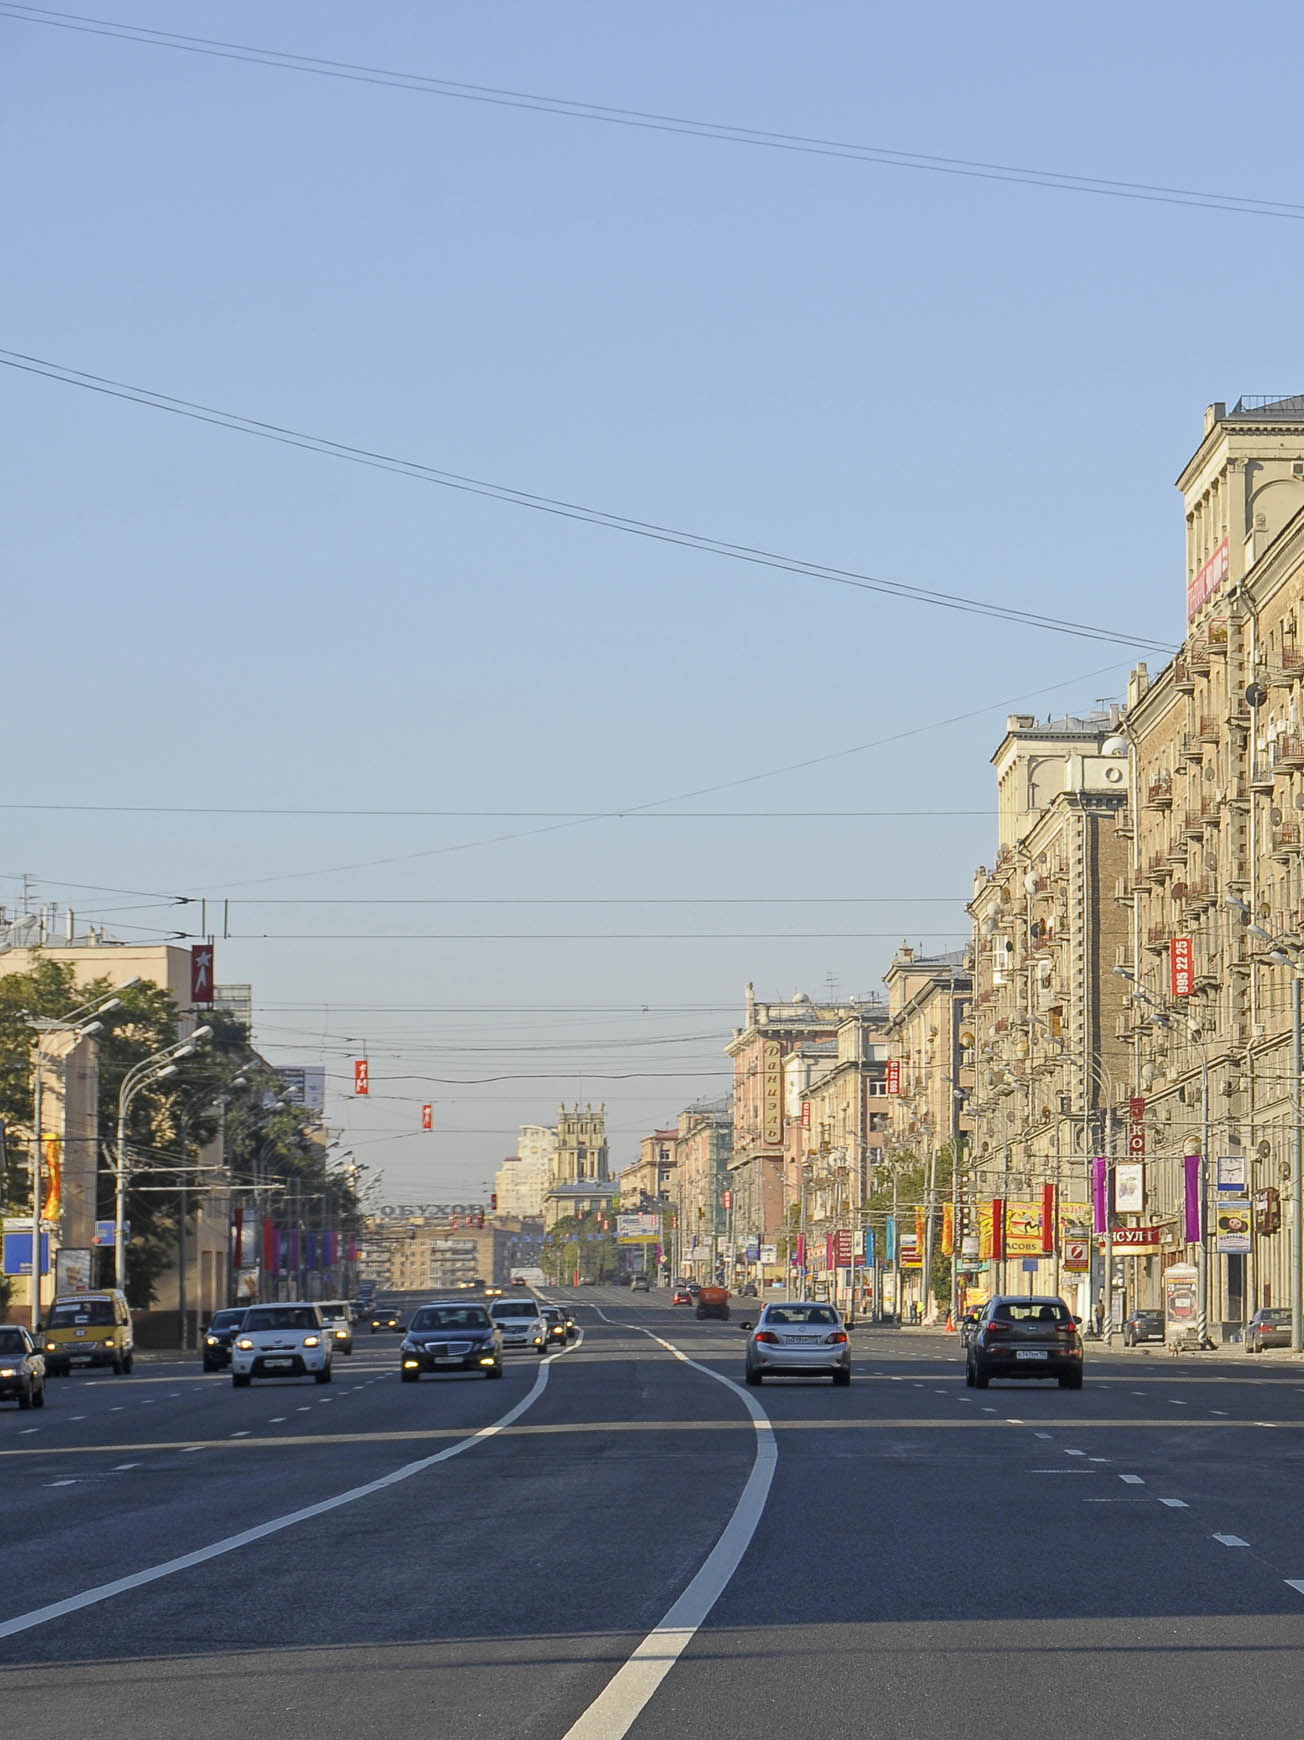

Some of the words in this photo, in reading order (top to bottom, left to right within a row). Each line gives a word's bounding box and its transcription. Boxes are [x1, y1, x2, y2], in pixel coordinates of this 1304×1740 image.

[1176, 956, 1188, 970] 22
[765, 1046, 779, 1138] Даниэль
[1006, 1243, 1037, 1251] ACOBS
